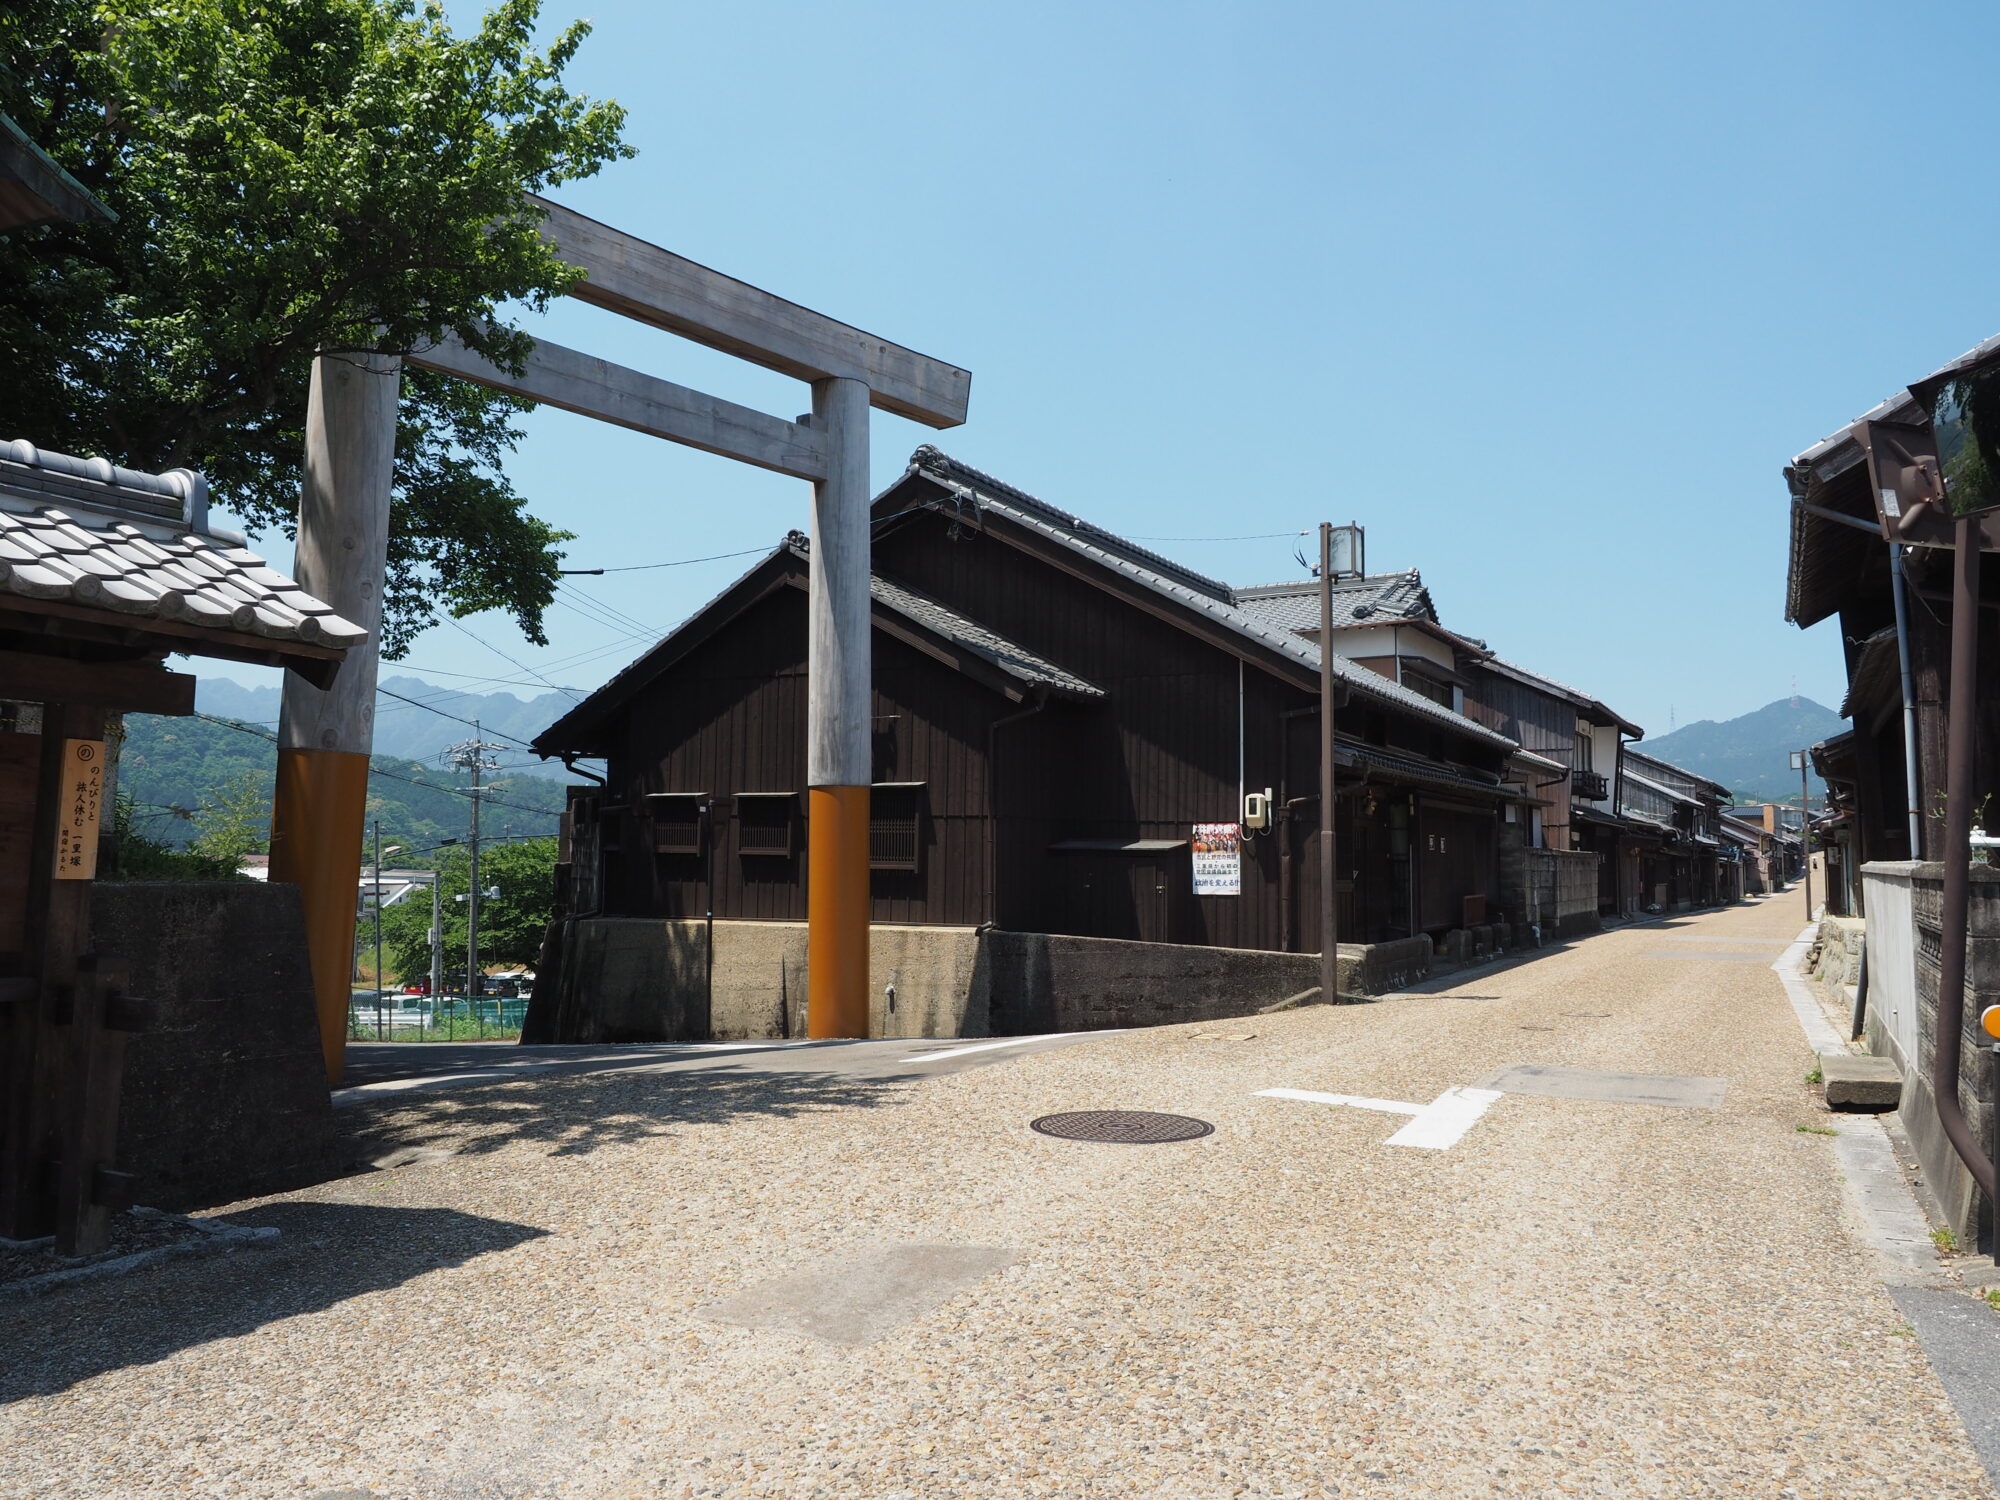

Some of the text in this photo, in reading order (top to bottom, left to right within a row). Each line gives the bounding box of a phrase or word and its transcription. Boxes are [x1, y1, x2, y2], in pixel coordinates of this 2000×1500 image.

[70, 781, 87, 867] 旅人休む 一里塚
[88, 766, 100, 821] のんびりと
